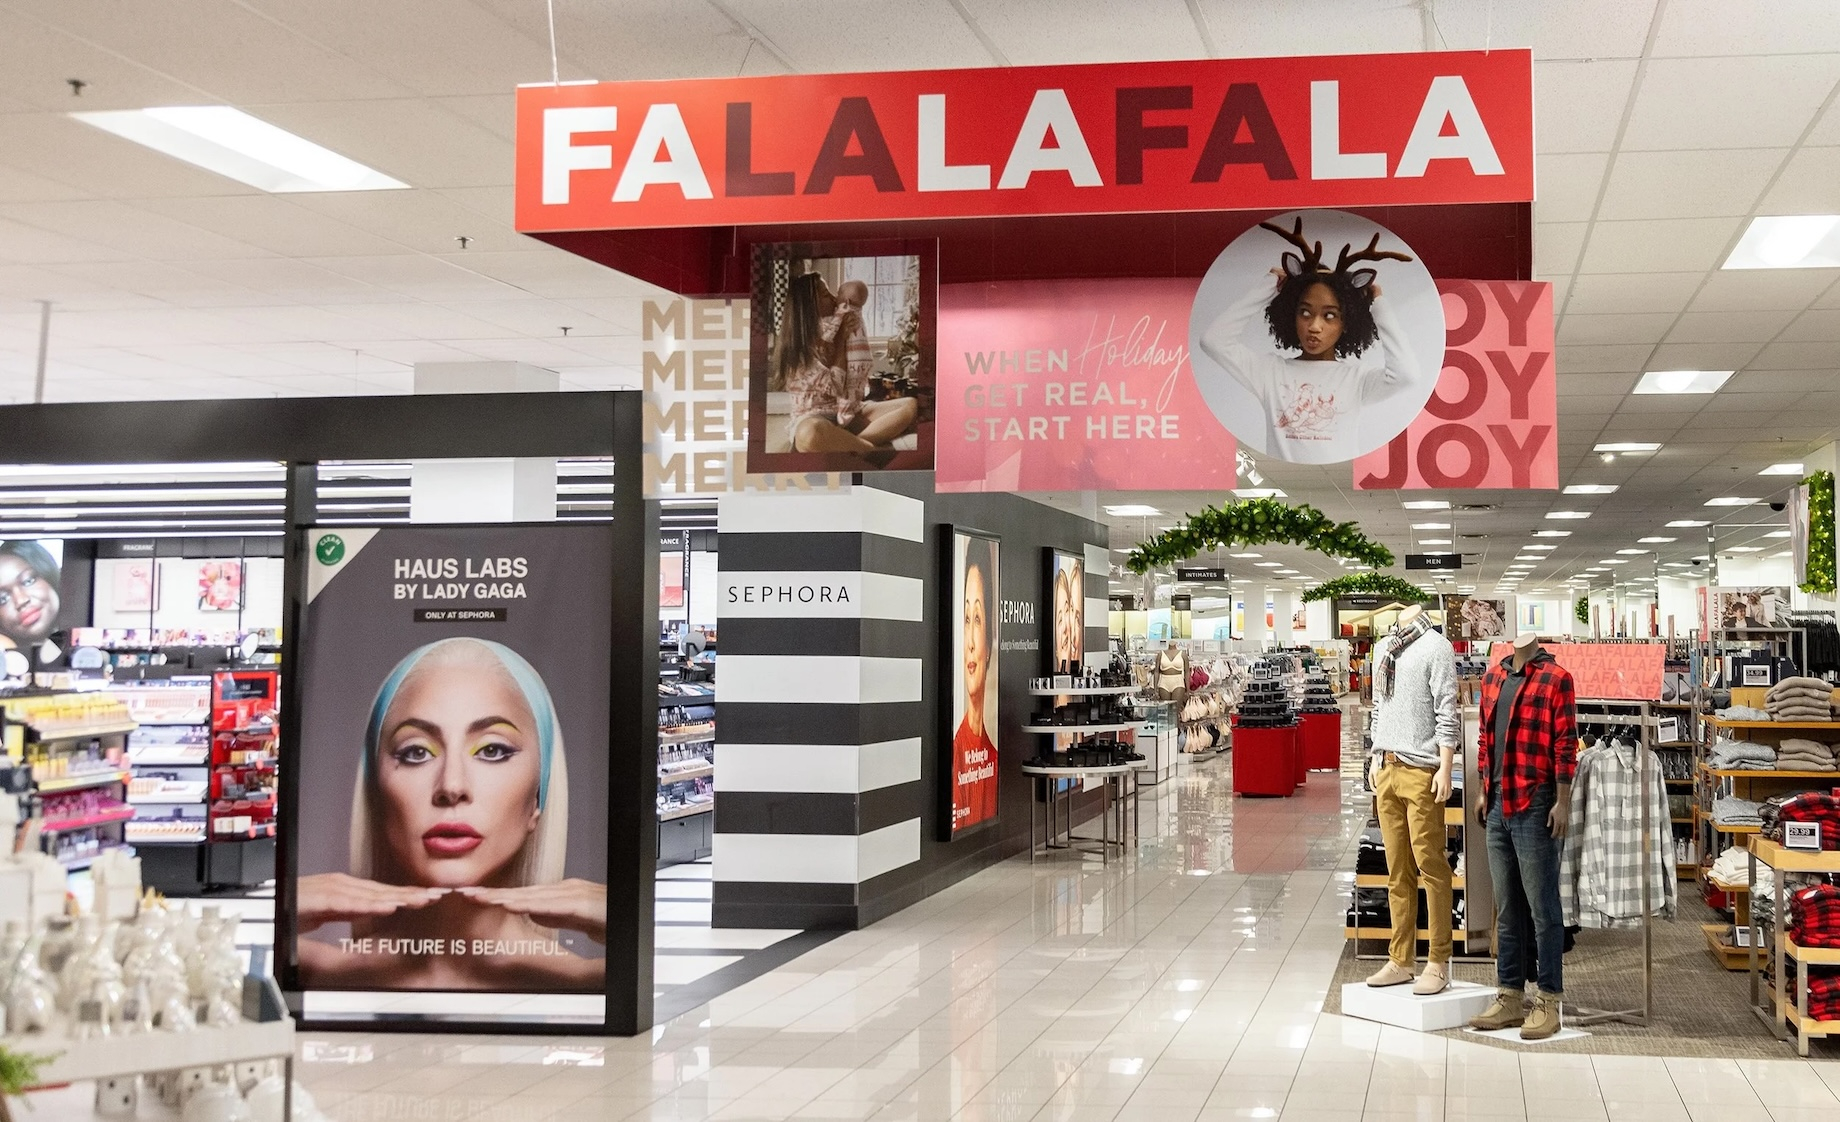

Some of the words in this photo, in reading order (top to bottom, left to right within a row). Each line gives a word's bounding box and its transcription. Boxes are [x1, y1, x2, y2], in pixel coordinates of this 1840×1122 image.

[1438, 279, 1546, 347] OY
[964, 349, 1069, 375] WHEN
[1074, 314, 1190, 413] Holiday
[964, 383, 1028, 409] GET
[1045, 381, 1147, 410] REAL,
[1424, 350, 1550, 420] OY
[964, 415, 1070, 442] START
[1086, 415, 1180, 440] HERE
[1358, 423, 1552, 489] JOY
[394, 558, 459, 579] HAUS
[465, 557, 528, 578] LABS
[394, 583, 418, 600] BY
[422, 583, 470, 599] LADY
[474, 582, 527, 599] GAGA
[728, 586, 850, 603] SEPHORA
[425, 611, 446, 619] ONLY
[1001, 600, 1035, 624] SEPHORA
[339, 938, 373, 955] THE
[378, 938, 445, 955] FUTURE
[451, 939, 466, 955] IS
